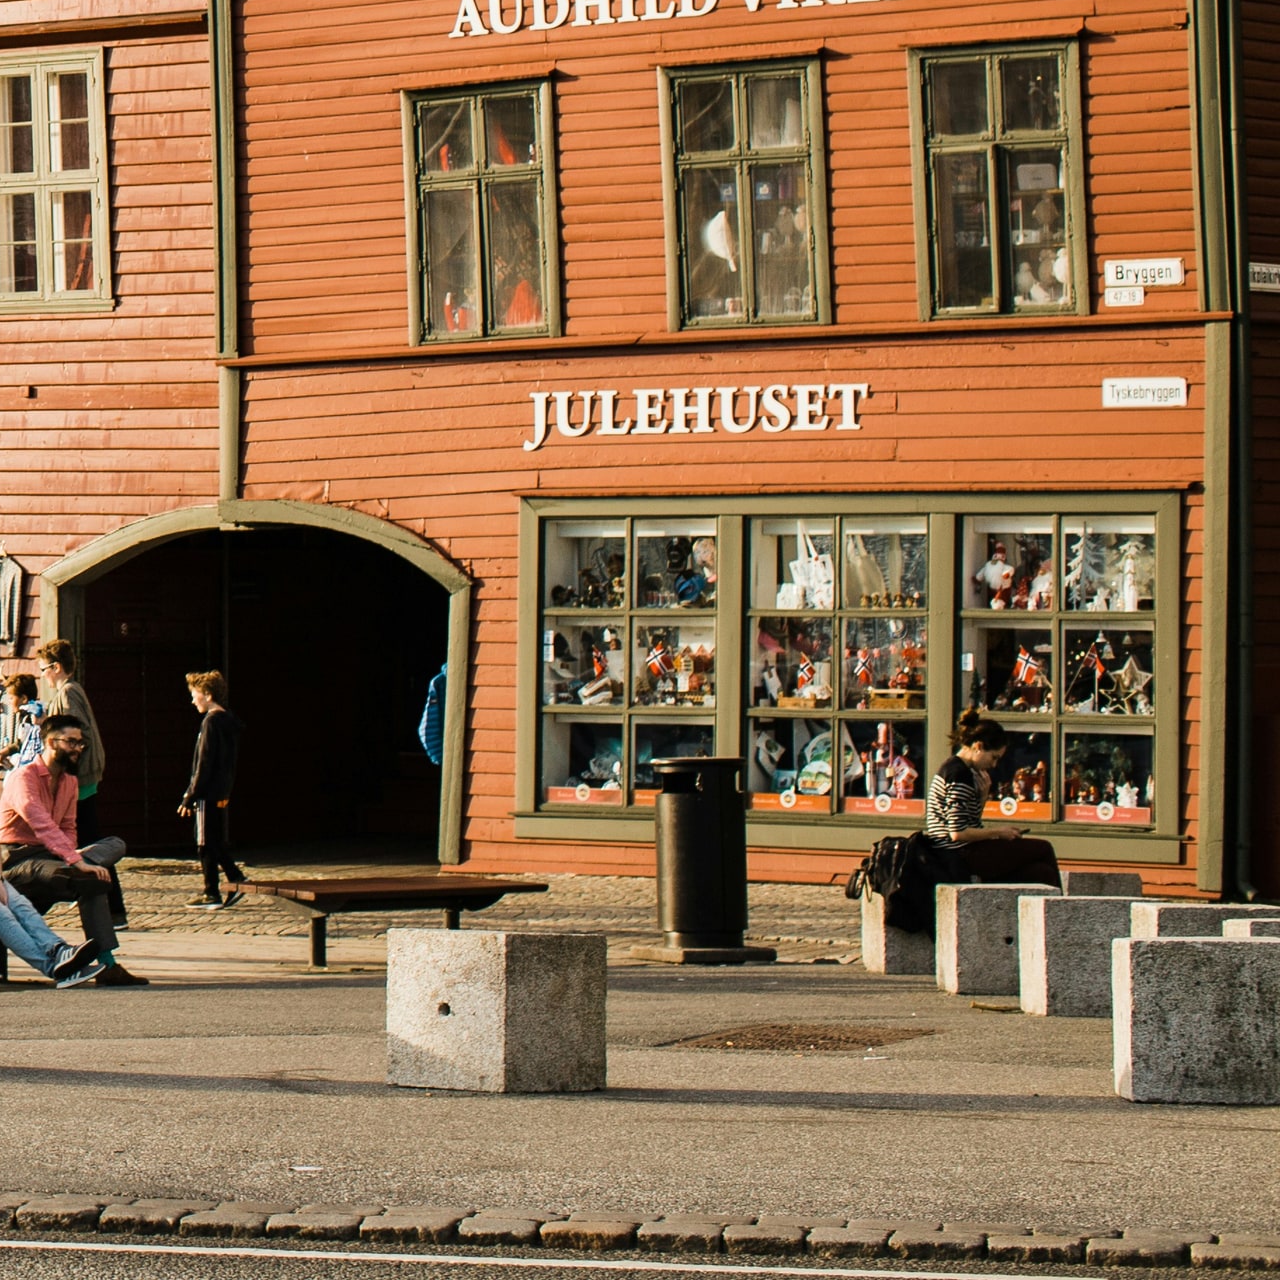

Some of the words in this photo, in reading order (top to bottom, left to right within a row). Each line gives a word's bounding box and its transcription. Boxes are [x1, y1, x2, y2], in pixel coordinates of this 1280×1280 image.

[1115, 265, 1172, 284] Bryggen
[1109, 384, 1181, 402] Tyskebryggen
[522, 383, 869, 452] JULEHUSET
